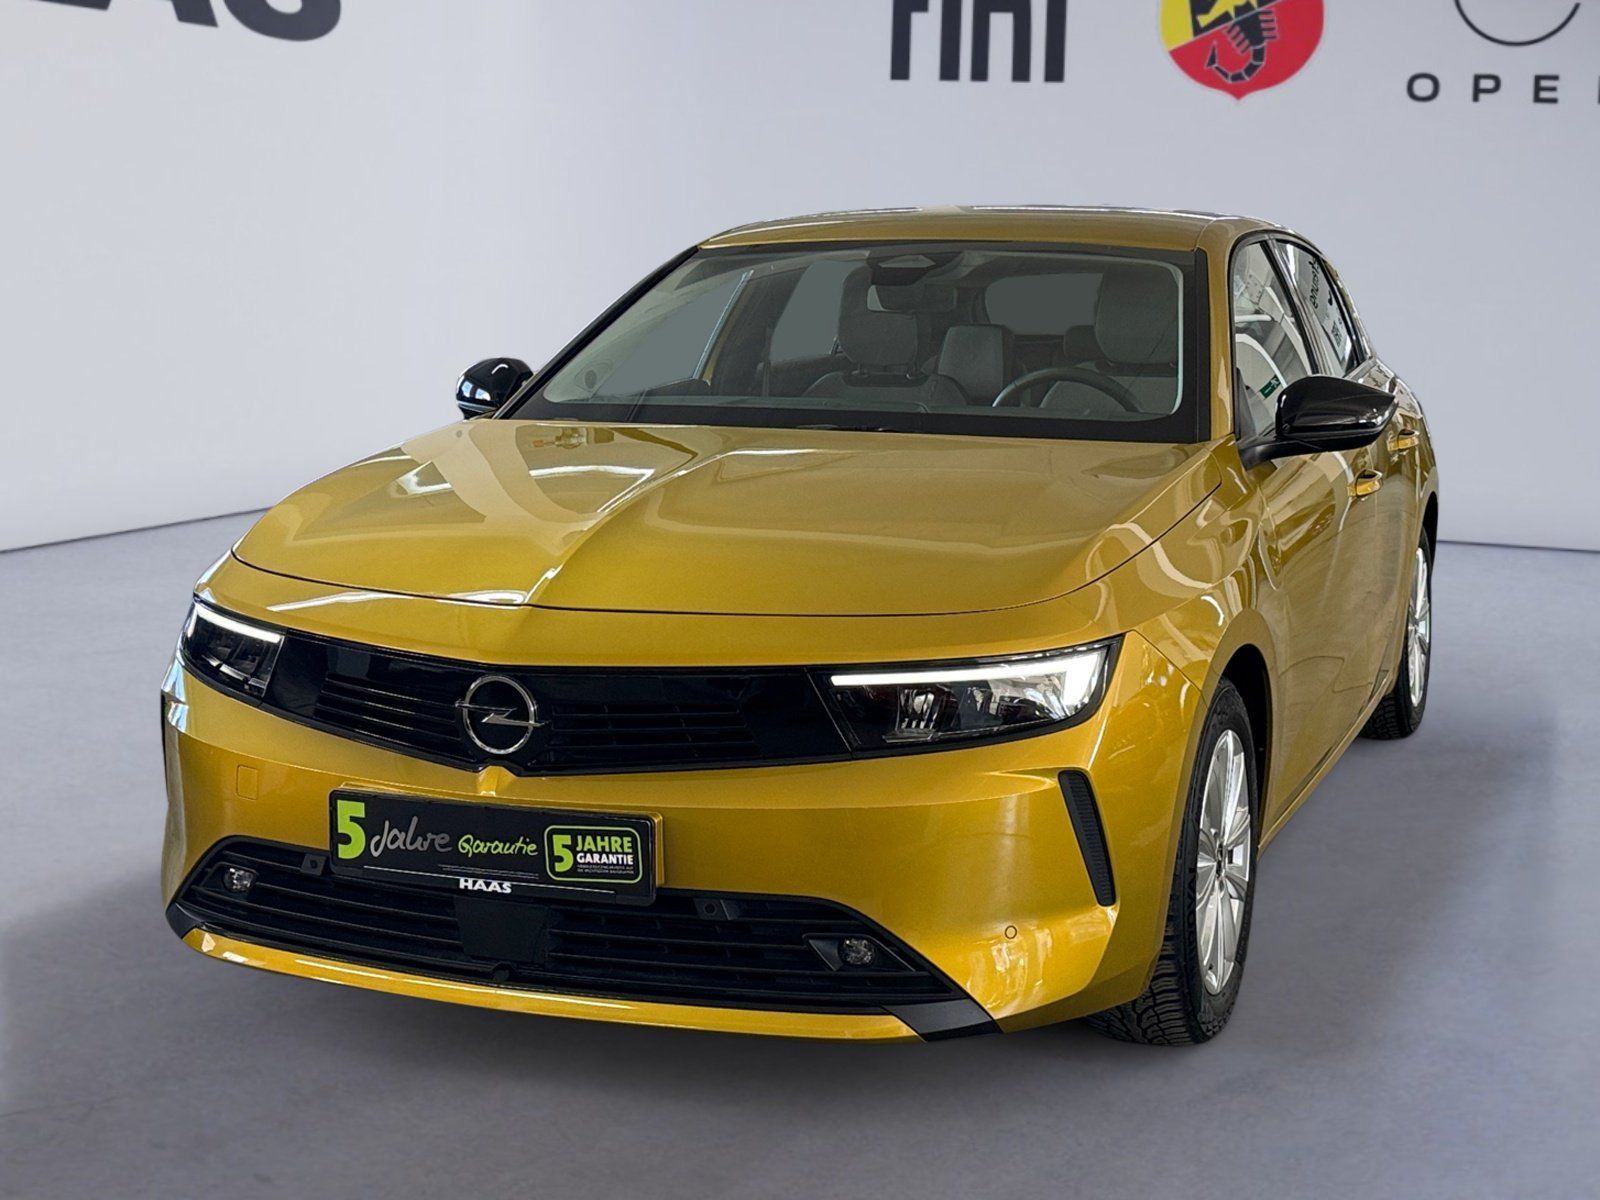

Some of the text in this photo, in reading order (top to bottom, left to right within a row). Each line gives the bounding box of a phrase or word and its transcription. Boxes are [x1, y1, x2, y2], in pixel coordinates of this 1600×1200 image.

[1406, 72, 1600, 104] OPE
[337, 800, 538, 859] 5 Jahre Garantie
[553, 835, 574, 872] 5
[576, 835, 633, 853] JAHRE
[576, 852, 635, 865] GARANTIE
[459, 878, 512, 894] HAAS
